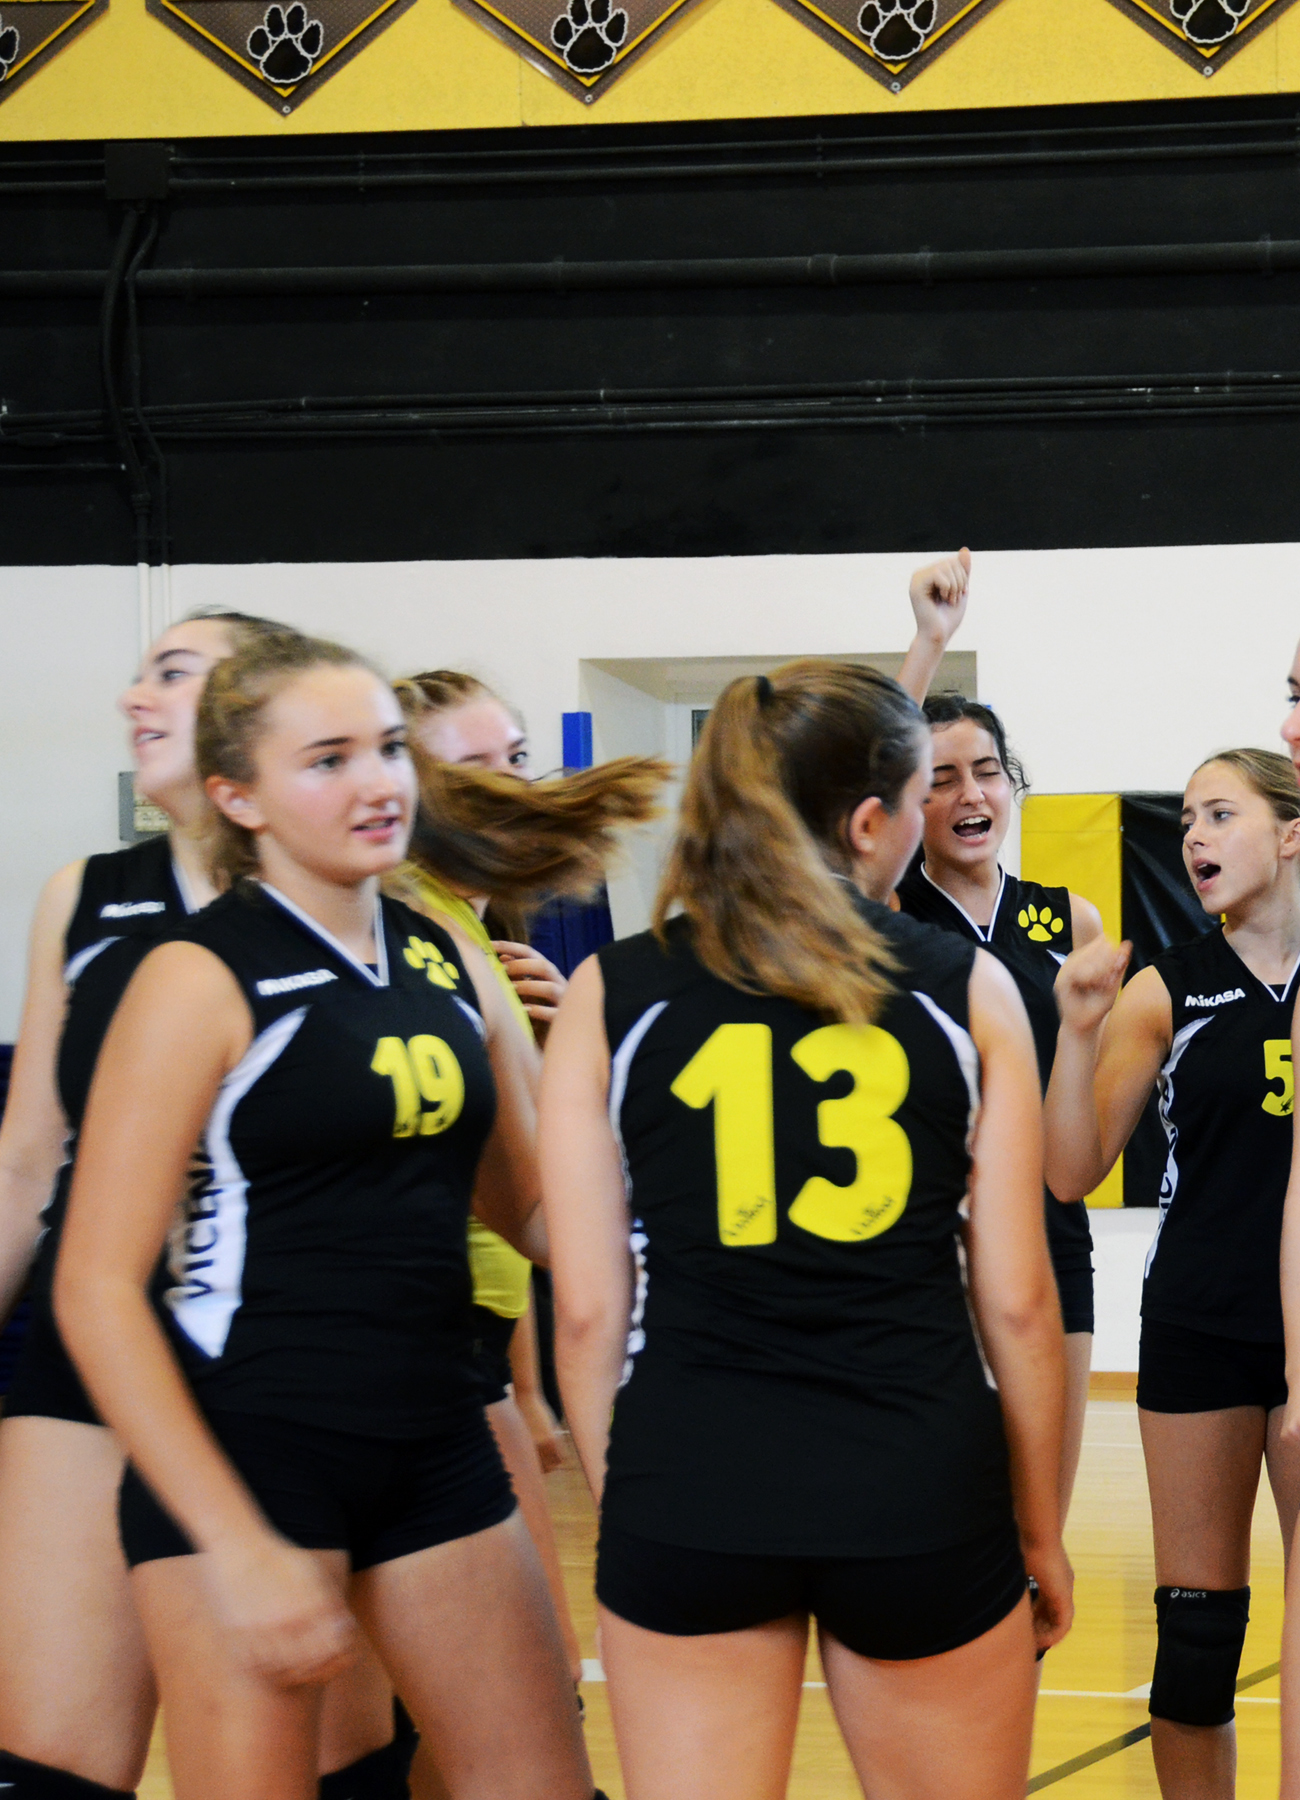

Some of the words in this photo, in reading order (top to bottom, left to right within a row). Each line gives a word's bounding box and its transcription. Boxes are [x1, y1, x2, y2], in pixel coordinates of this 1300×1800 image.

[370, 1033, 465, 1138] 19
[1261, 1039, 1295, 1116] 5
[670, 1022, 913, 1246] 13
